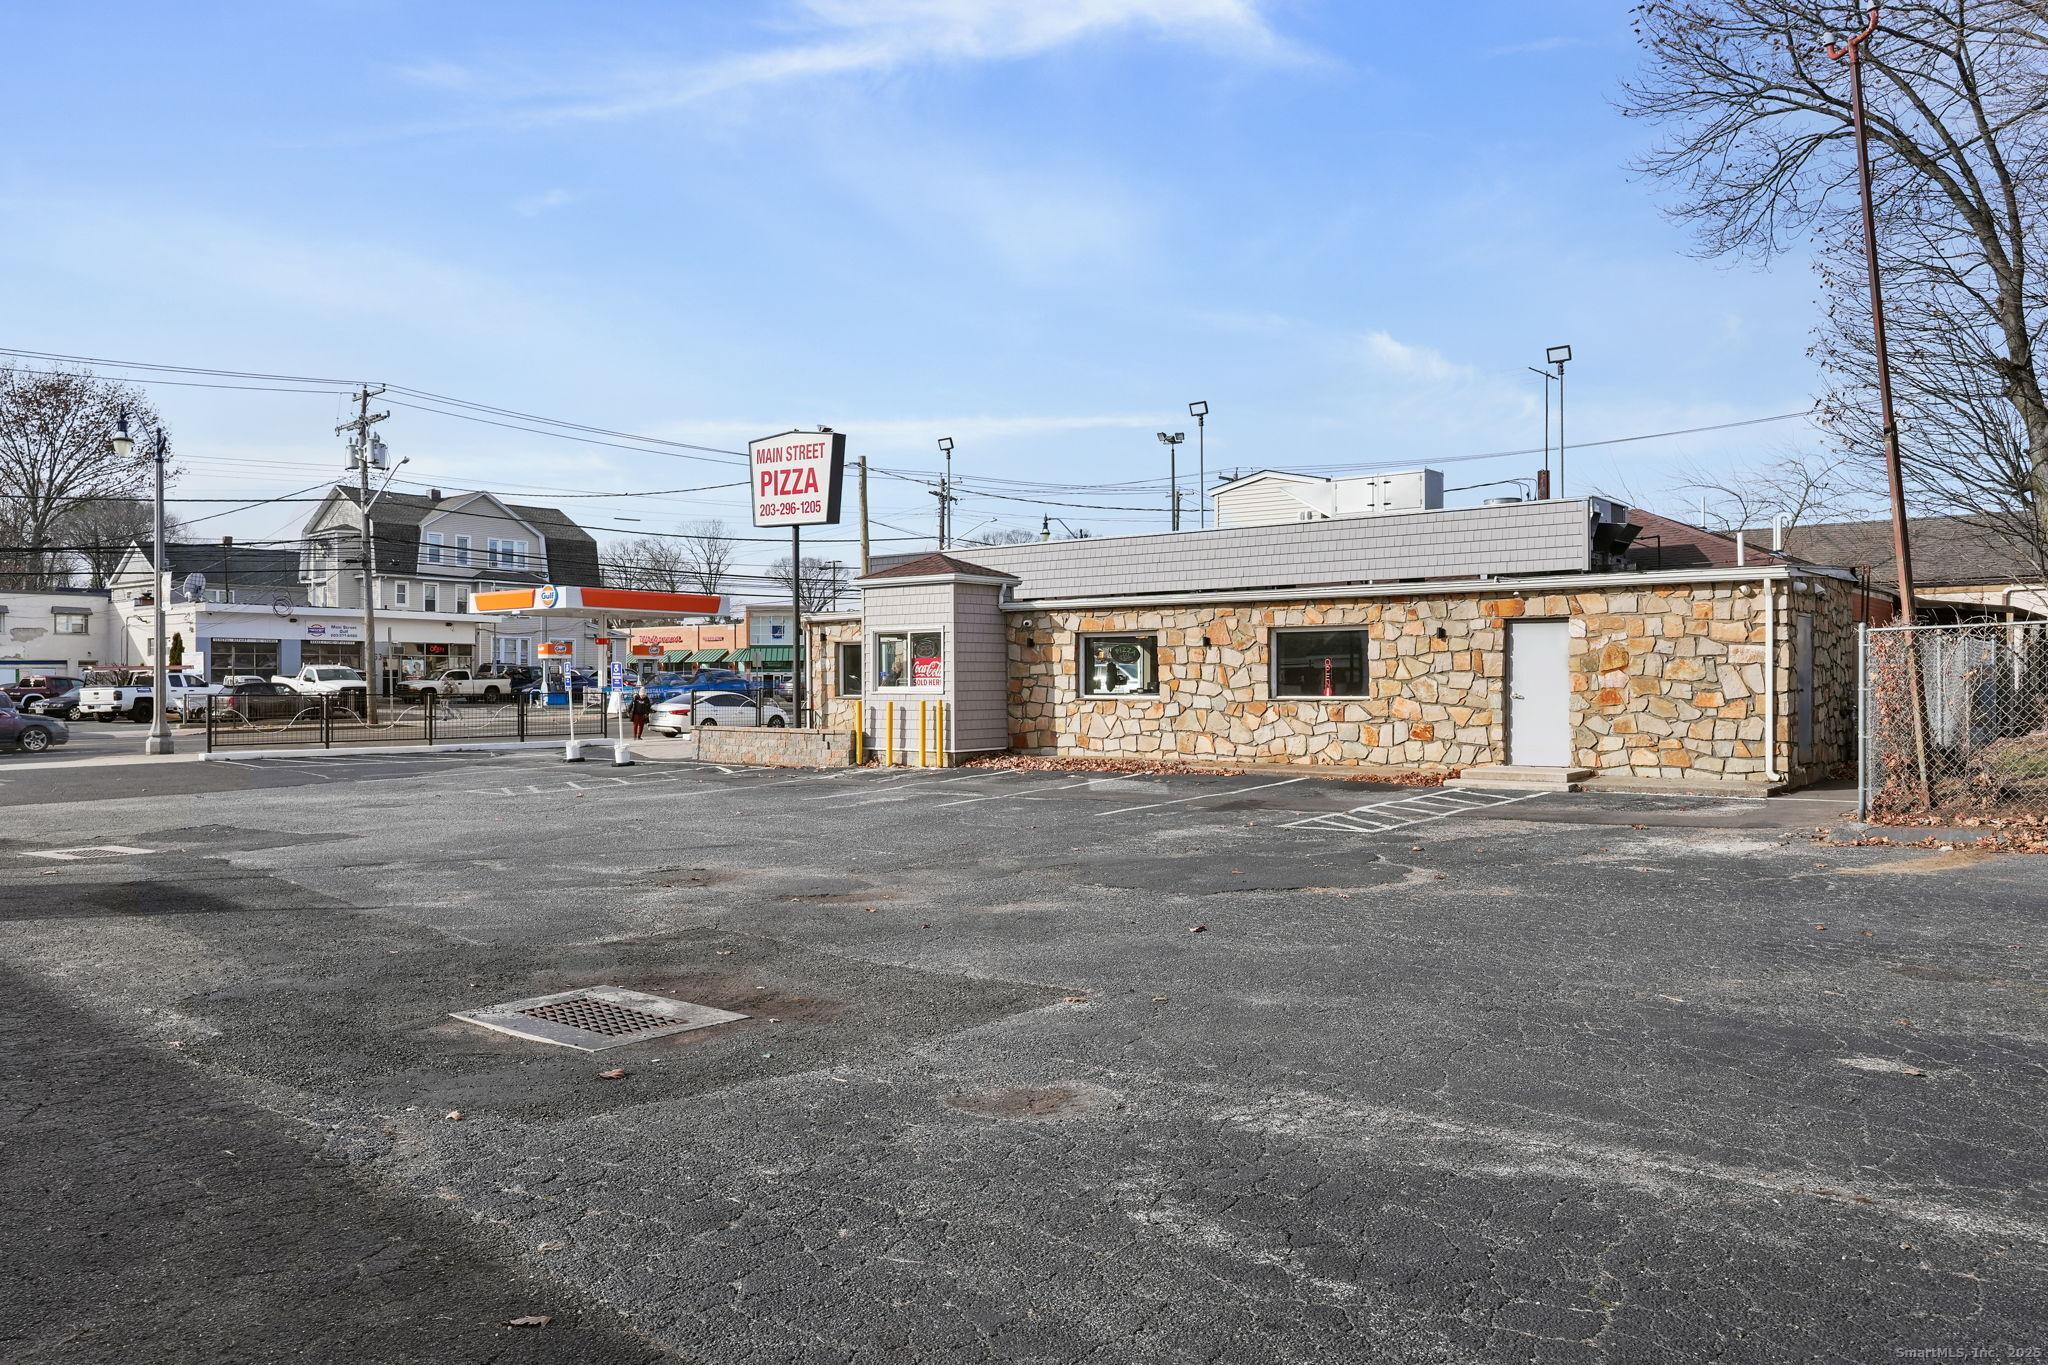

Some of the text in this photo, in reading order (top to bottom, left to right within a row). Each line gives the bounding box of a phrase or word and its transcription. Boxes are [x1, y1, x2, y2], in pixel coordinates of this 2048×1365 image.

[757, 443, 825, 464] MAIN STREET
[761, 468, 818, 496] PIZZA
[760, 500, 821, 516] 203-296-1205
[541, 591, 554, 600] Gulf
